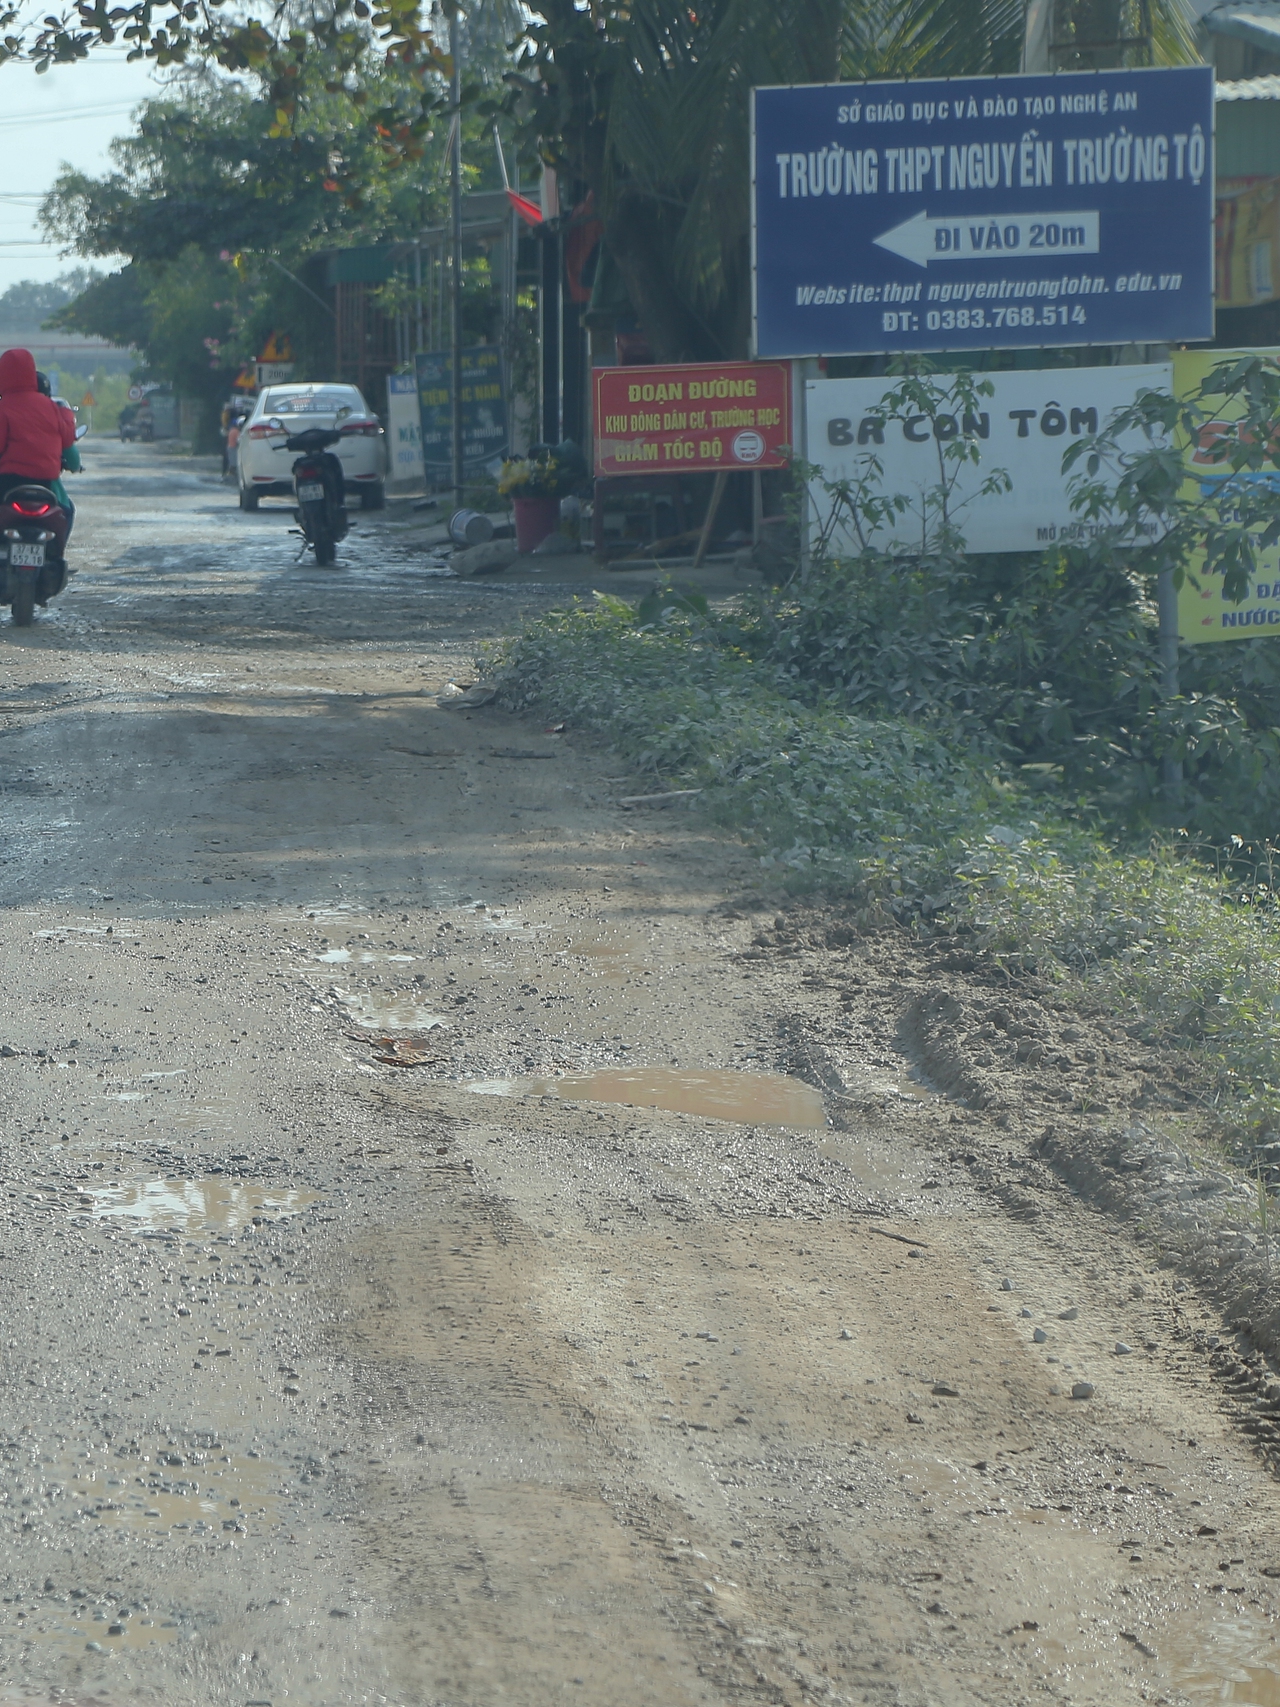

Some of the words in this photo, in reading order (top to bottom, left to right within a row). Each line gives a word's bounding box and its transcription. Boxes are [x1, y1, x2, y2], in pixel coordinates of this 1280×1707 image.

[837, 98, 862, 124] SỞ
[865, 99, 905, 123] GIÁO
[912, 100, 949, 125] DỤC
[954, 95, 979, 119] VÀ
[983, 94, 1019, 118] ĐÀO
[1023, 95, 1056, 119] TẠO
[1060, 89, 1108, 116] NGHỆ
[1113, 91, 1138, 112] AN
[776, 141, 879, 198] TRƯỜNG
[885, 145, 945, 194] THPT
[949, 128, 1053, 190] NGUYỄN
[1063, 125, 1169, 186] TRƯỜNG
[1173, 123, 1205, 186] TỘ
[934, 228, 961, 252] ĐI
[969, 221, 1020, 251] VÀO
[1029, 223, 1086, 249] 20m
[883, 311, 920, 332] ĐT:
[926, 305, 1087, 331] 0383.768.514
[628, 382, 683, 405] ĐOẠN
[688, 376, 757, 399] ĐƯỜNG
[605, 414, 627, 433] KHU
[630, 410, 661, 432] ĐÔNG
[663, 408, 687, 431] DÂN
[689, 408, 708, 431] CƯ,
[710, 406, 756, 429] TRƯỜNG
[757, 407, 781, 430] HỌC
[902, 411, 991, 442] CON
[1008, 400, 1099, 439] TÔM
[663, 435, 696, 461] TỐC
[699, 436, 724, 462] ĐỘ
[1036, 522, 1057, 541] MỞ
[1221, 607, 1280, 628] NƯỚC
